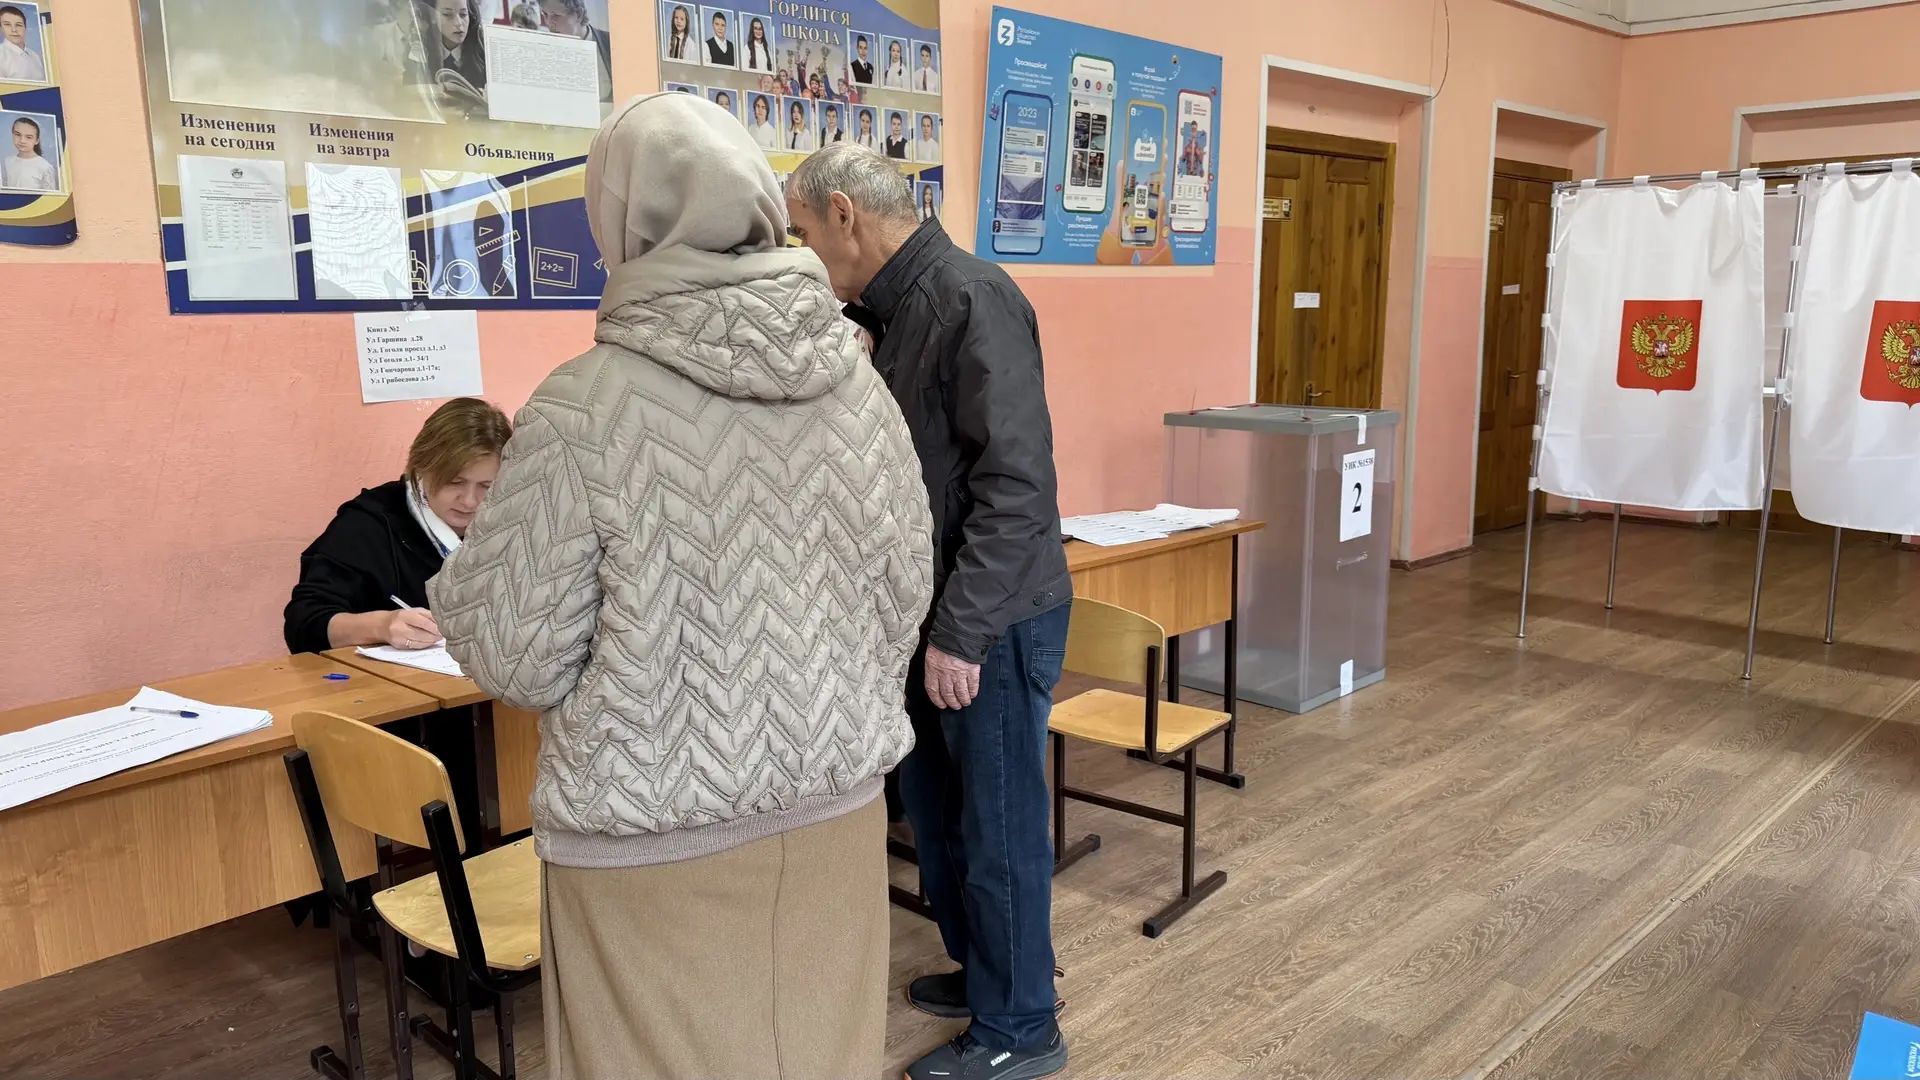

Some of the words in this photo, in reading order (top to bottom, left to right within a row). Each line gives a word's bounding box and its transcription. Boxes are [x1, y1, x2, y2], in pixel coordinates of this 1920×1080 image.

[769, 0, 850, 26] ГОРДИТСЯ
[782, 23, 840, 46] ШКОЛА
[180, 113, 276, 134] Изменения
[309, 122, 395, 142] Изменения
[184, 135, 206, 146] на
[211, 136, 276, 151] сегодня
[317, 143, 336, 154] на
[339, 145, 390, 160] завтра
[464, 142, 555, 162] Объявления
[540, 261, 565, 273] 2+2=
[388, 325, 401, 333] №2
[377, 336, 408, 344] Гаршина
[380, 366, 416, 374] Гончарова
[381, 376, 419, 385] Грибоедова
[1352, 482, 1362, 513] 2
